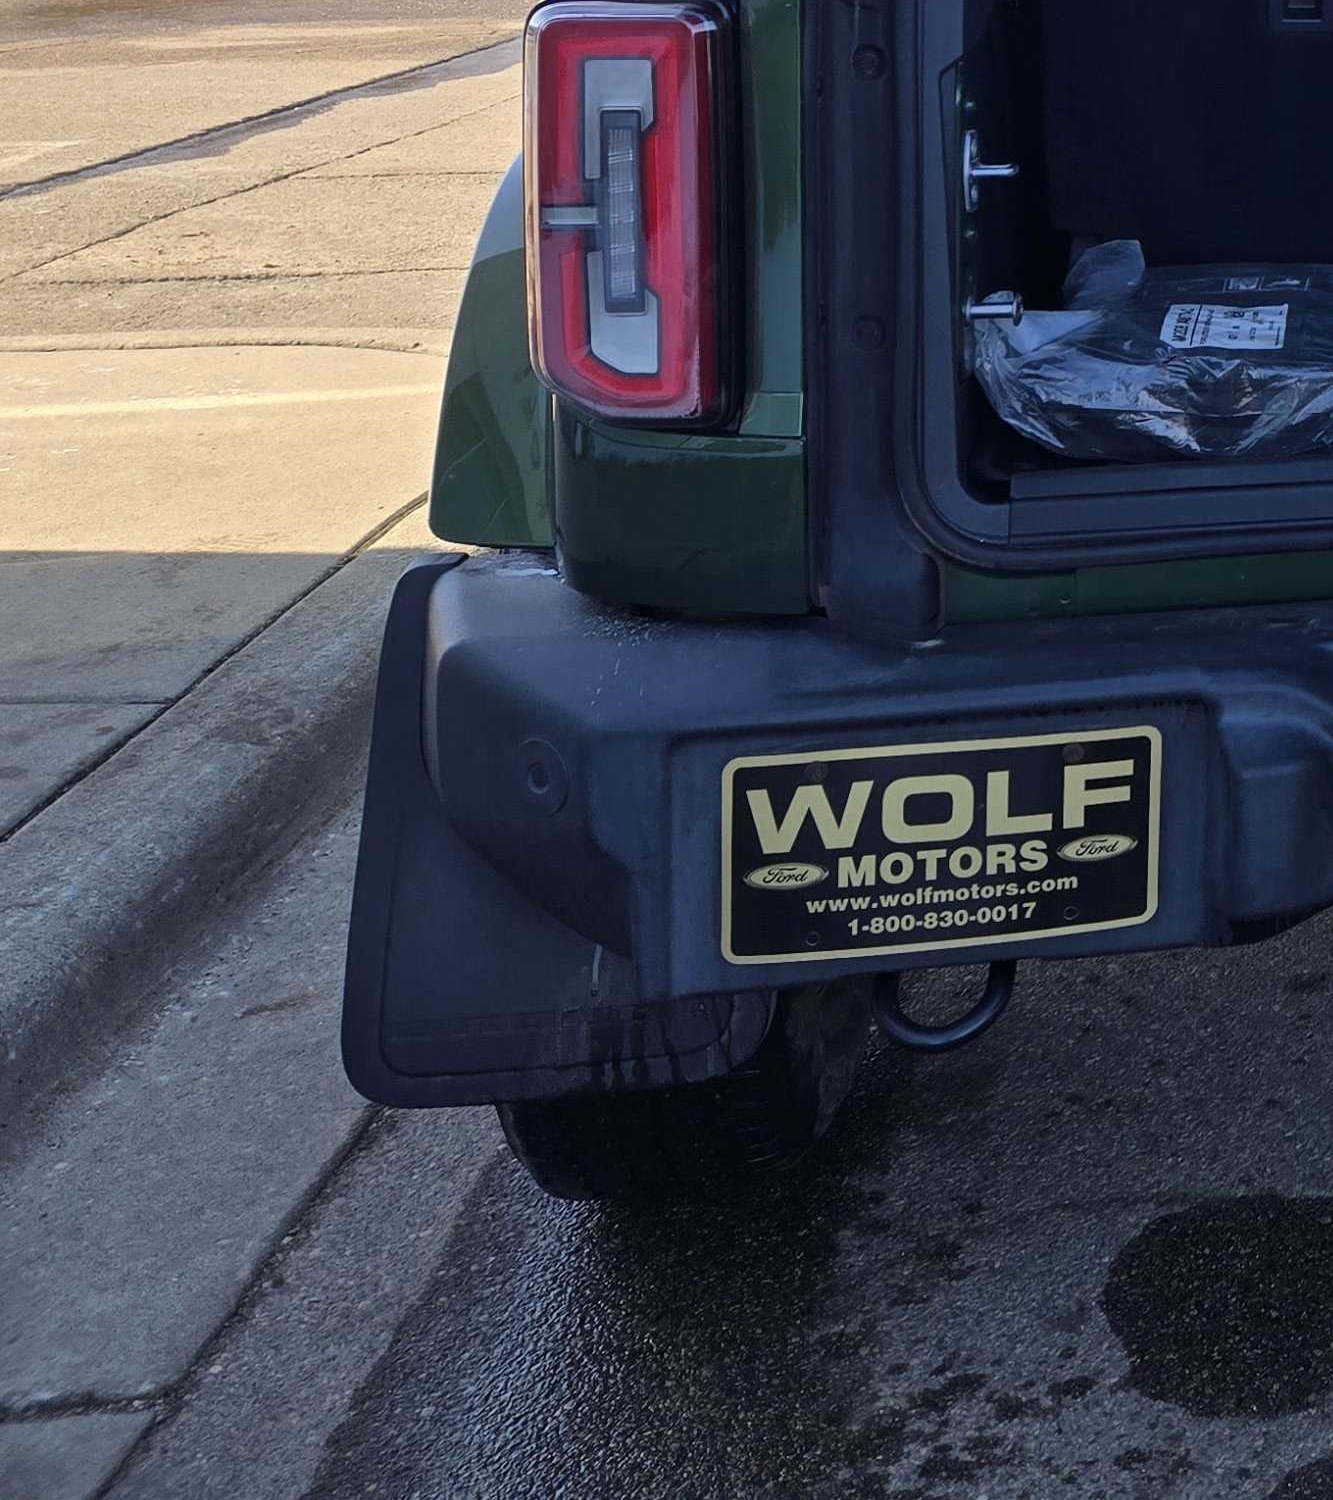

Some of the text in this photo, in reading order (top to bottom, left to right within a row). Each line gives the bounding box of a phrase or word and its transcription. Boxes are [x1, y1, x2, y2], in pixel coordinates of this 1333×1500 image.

[745, 758, 1135, 855] WOLF
[837, 839, 1049, 889] MOTORS
[1075, 837, 1119, 856] Ford
[762, 866, 808, 885] Ford
[805, 874, 1079, 914] www.wolfmotors.com
[847, 901, 1038, 936] 1-800-830-0017
